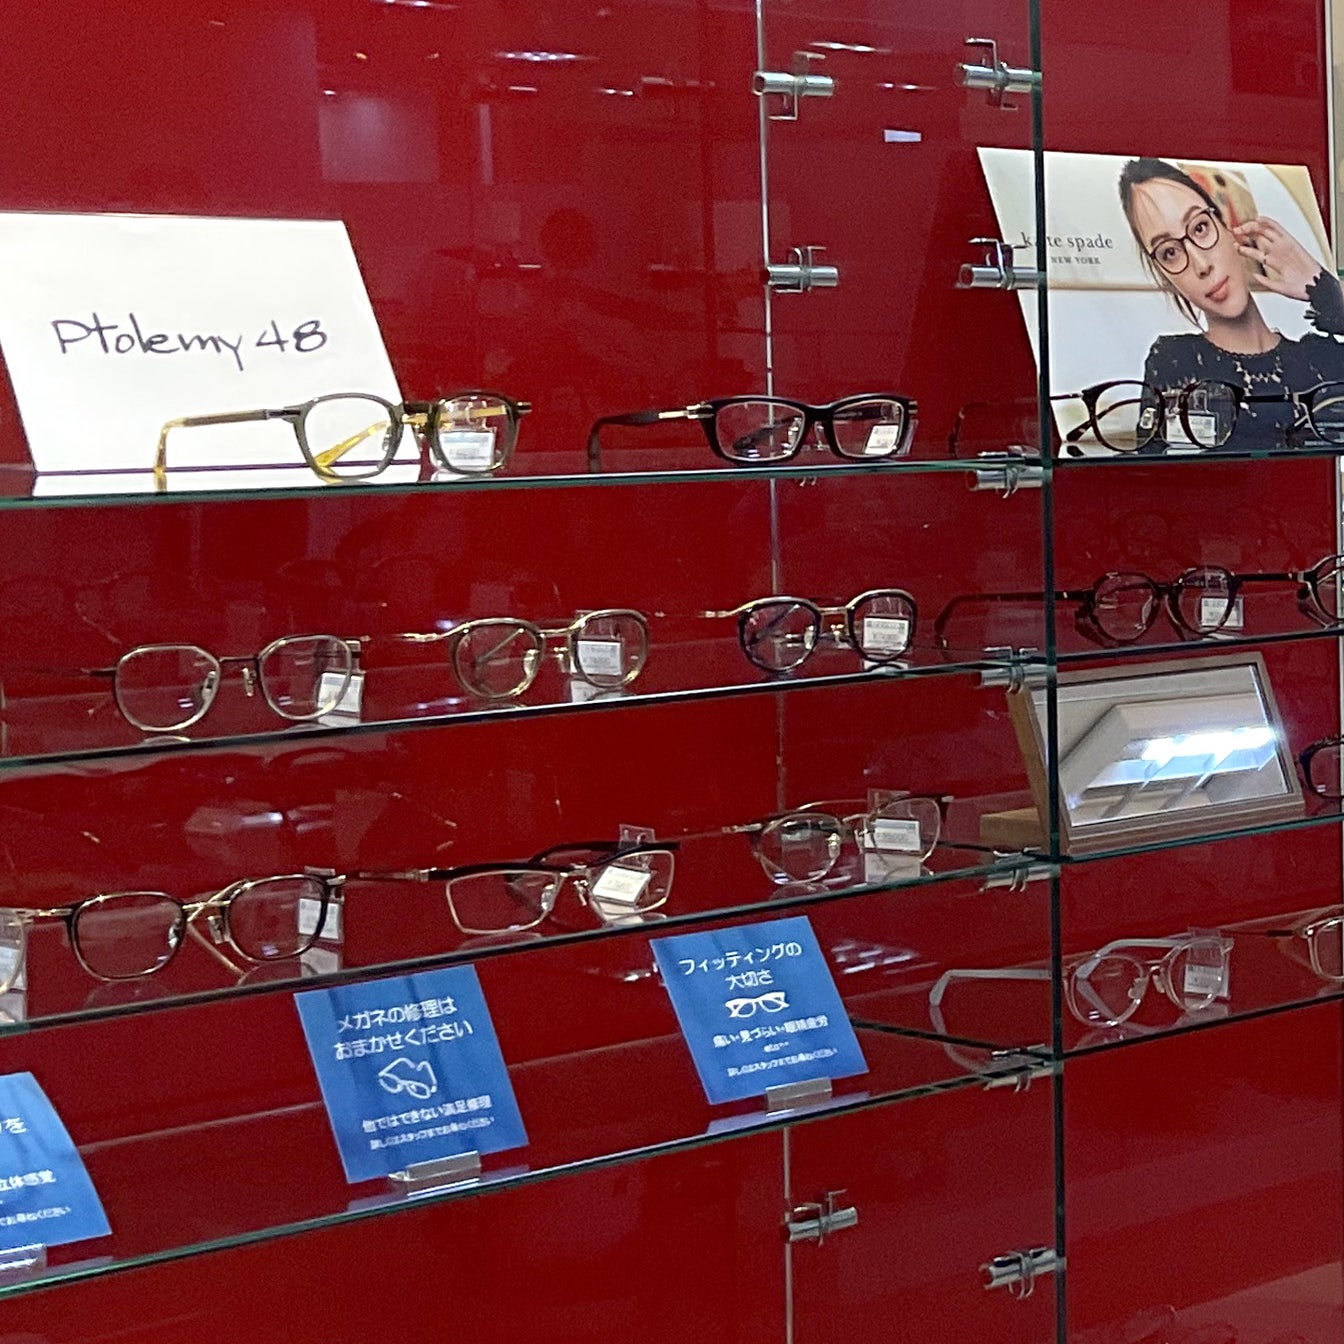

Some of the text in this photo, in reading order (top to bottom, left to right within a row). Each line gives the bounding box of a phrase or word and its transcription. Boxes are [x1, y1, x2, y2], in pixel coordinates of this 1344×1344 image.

[1021, 231, 1113, 252] kte spade
[1051, 256, 1101, 265] NEW YORK
[50, 312, 328, 372] Ptolemy 48
[679, 942, 803, 976] フィッティングの
[725, 969, 774, 990] 大切さ
[337, 996, 458, 1034] メガネの修理は
[333, 1019, 474, 1061] おまかせください
